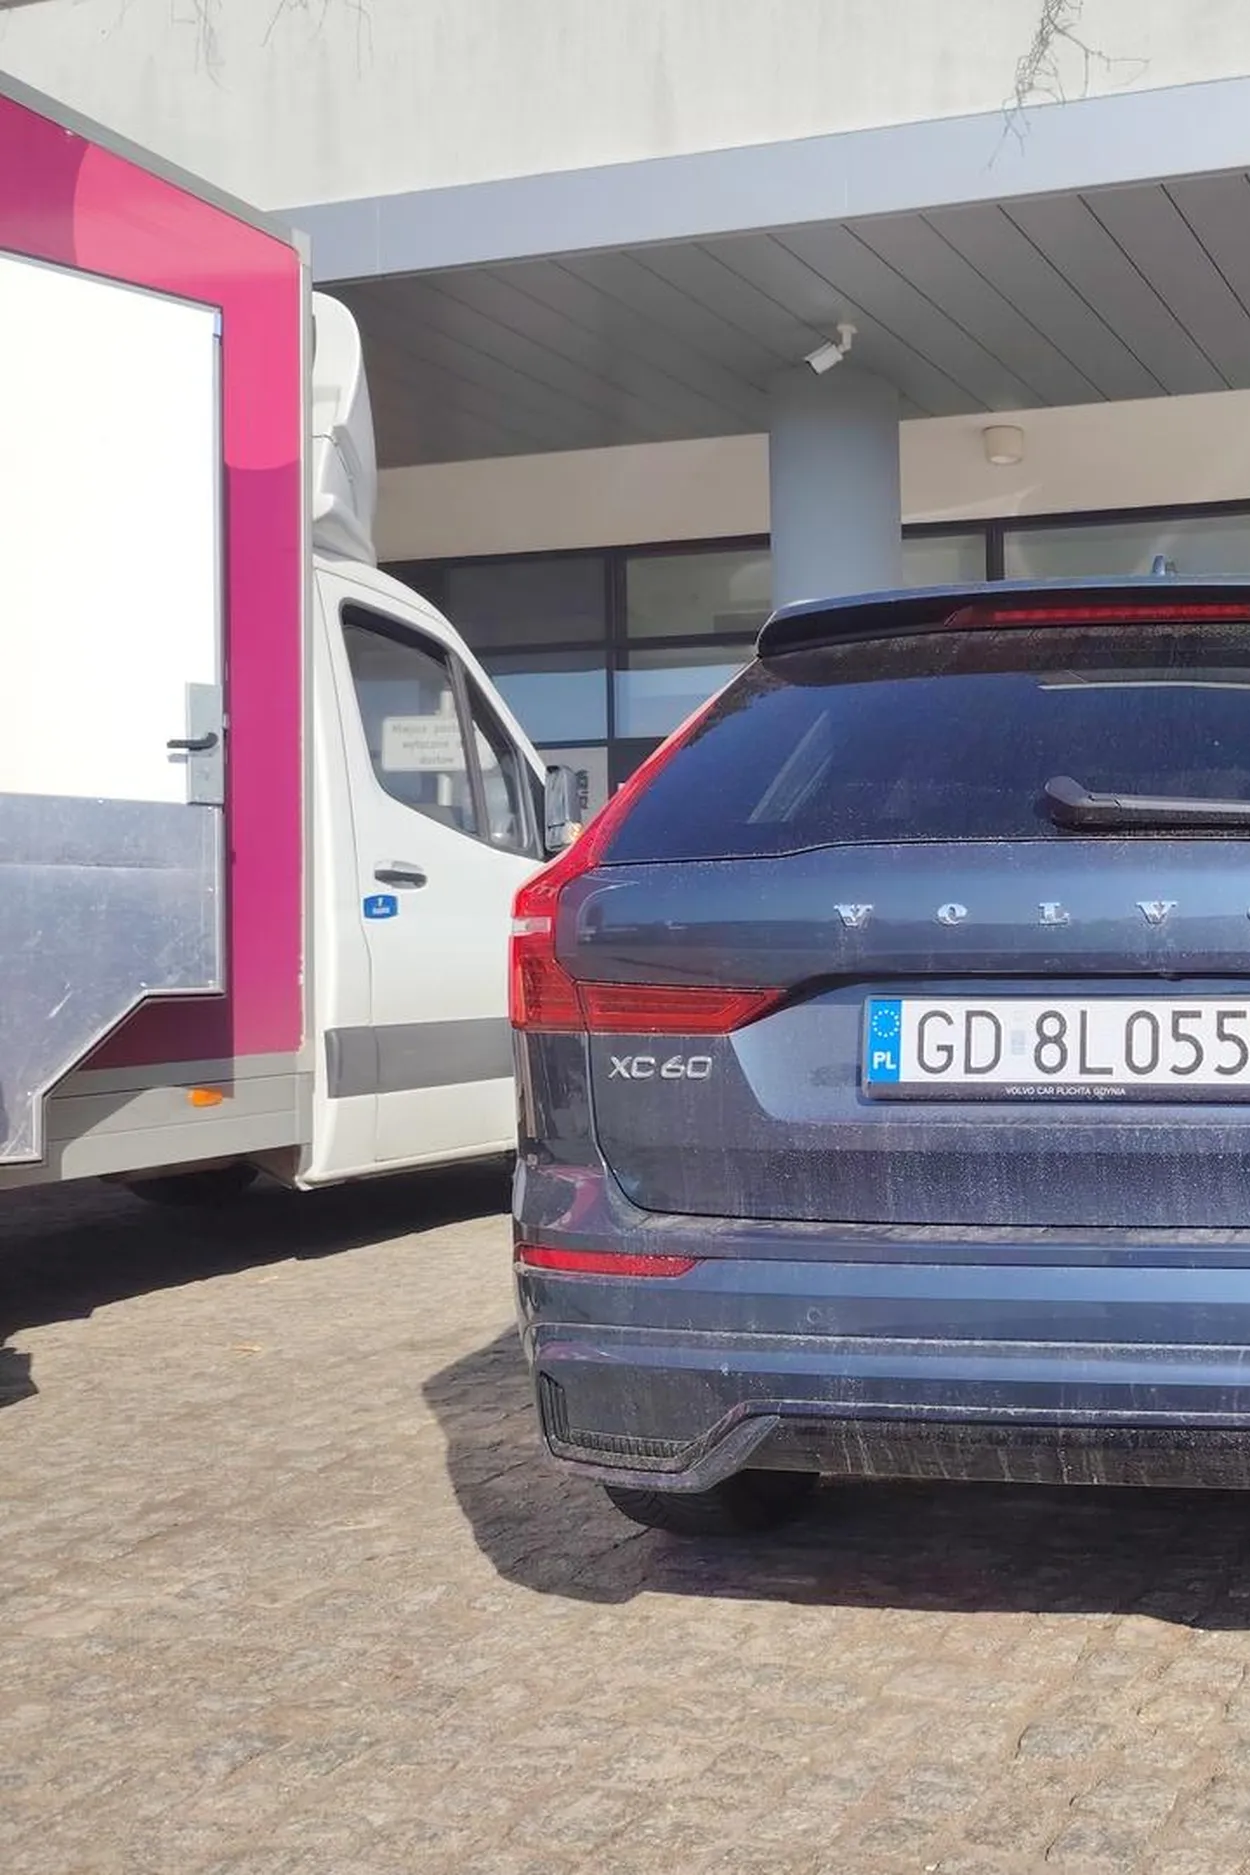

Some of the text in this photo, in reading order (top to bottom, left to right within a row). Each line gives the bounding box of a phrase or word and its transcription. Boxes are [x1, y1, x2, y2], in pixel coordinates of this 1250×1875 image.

[916, 1009, 1250, 1076] GD 8L055
[872, 1051, 896, 1070] PL
[1005, 1085, 1035, 1096] VOLVO
[1037, 1085, 1054, 1096] CAR
[1093, 1085, 1126, 1096] GDYNIA
